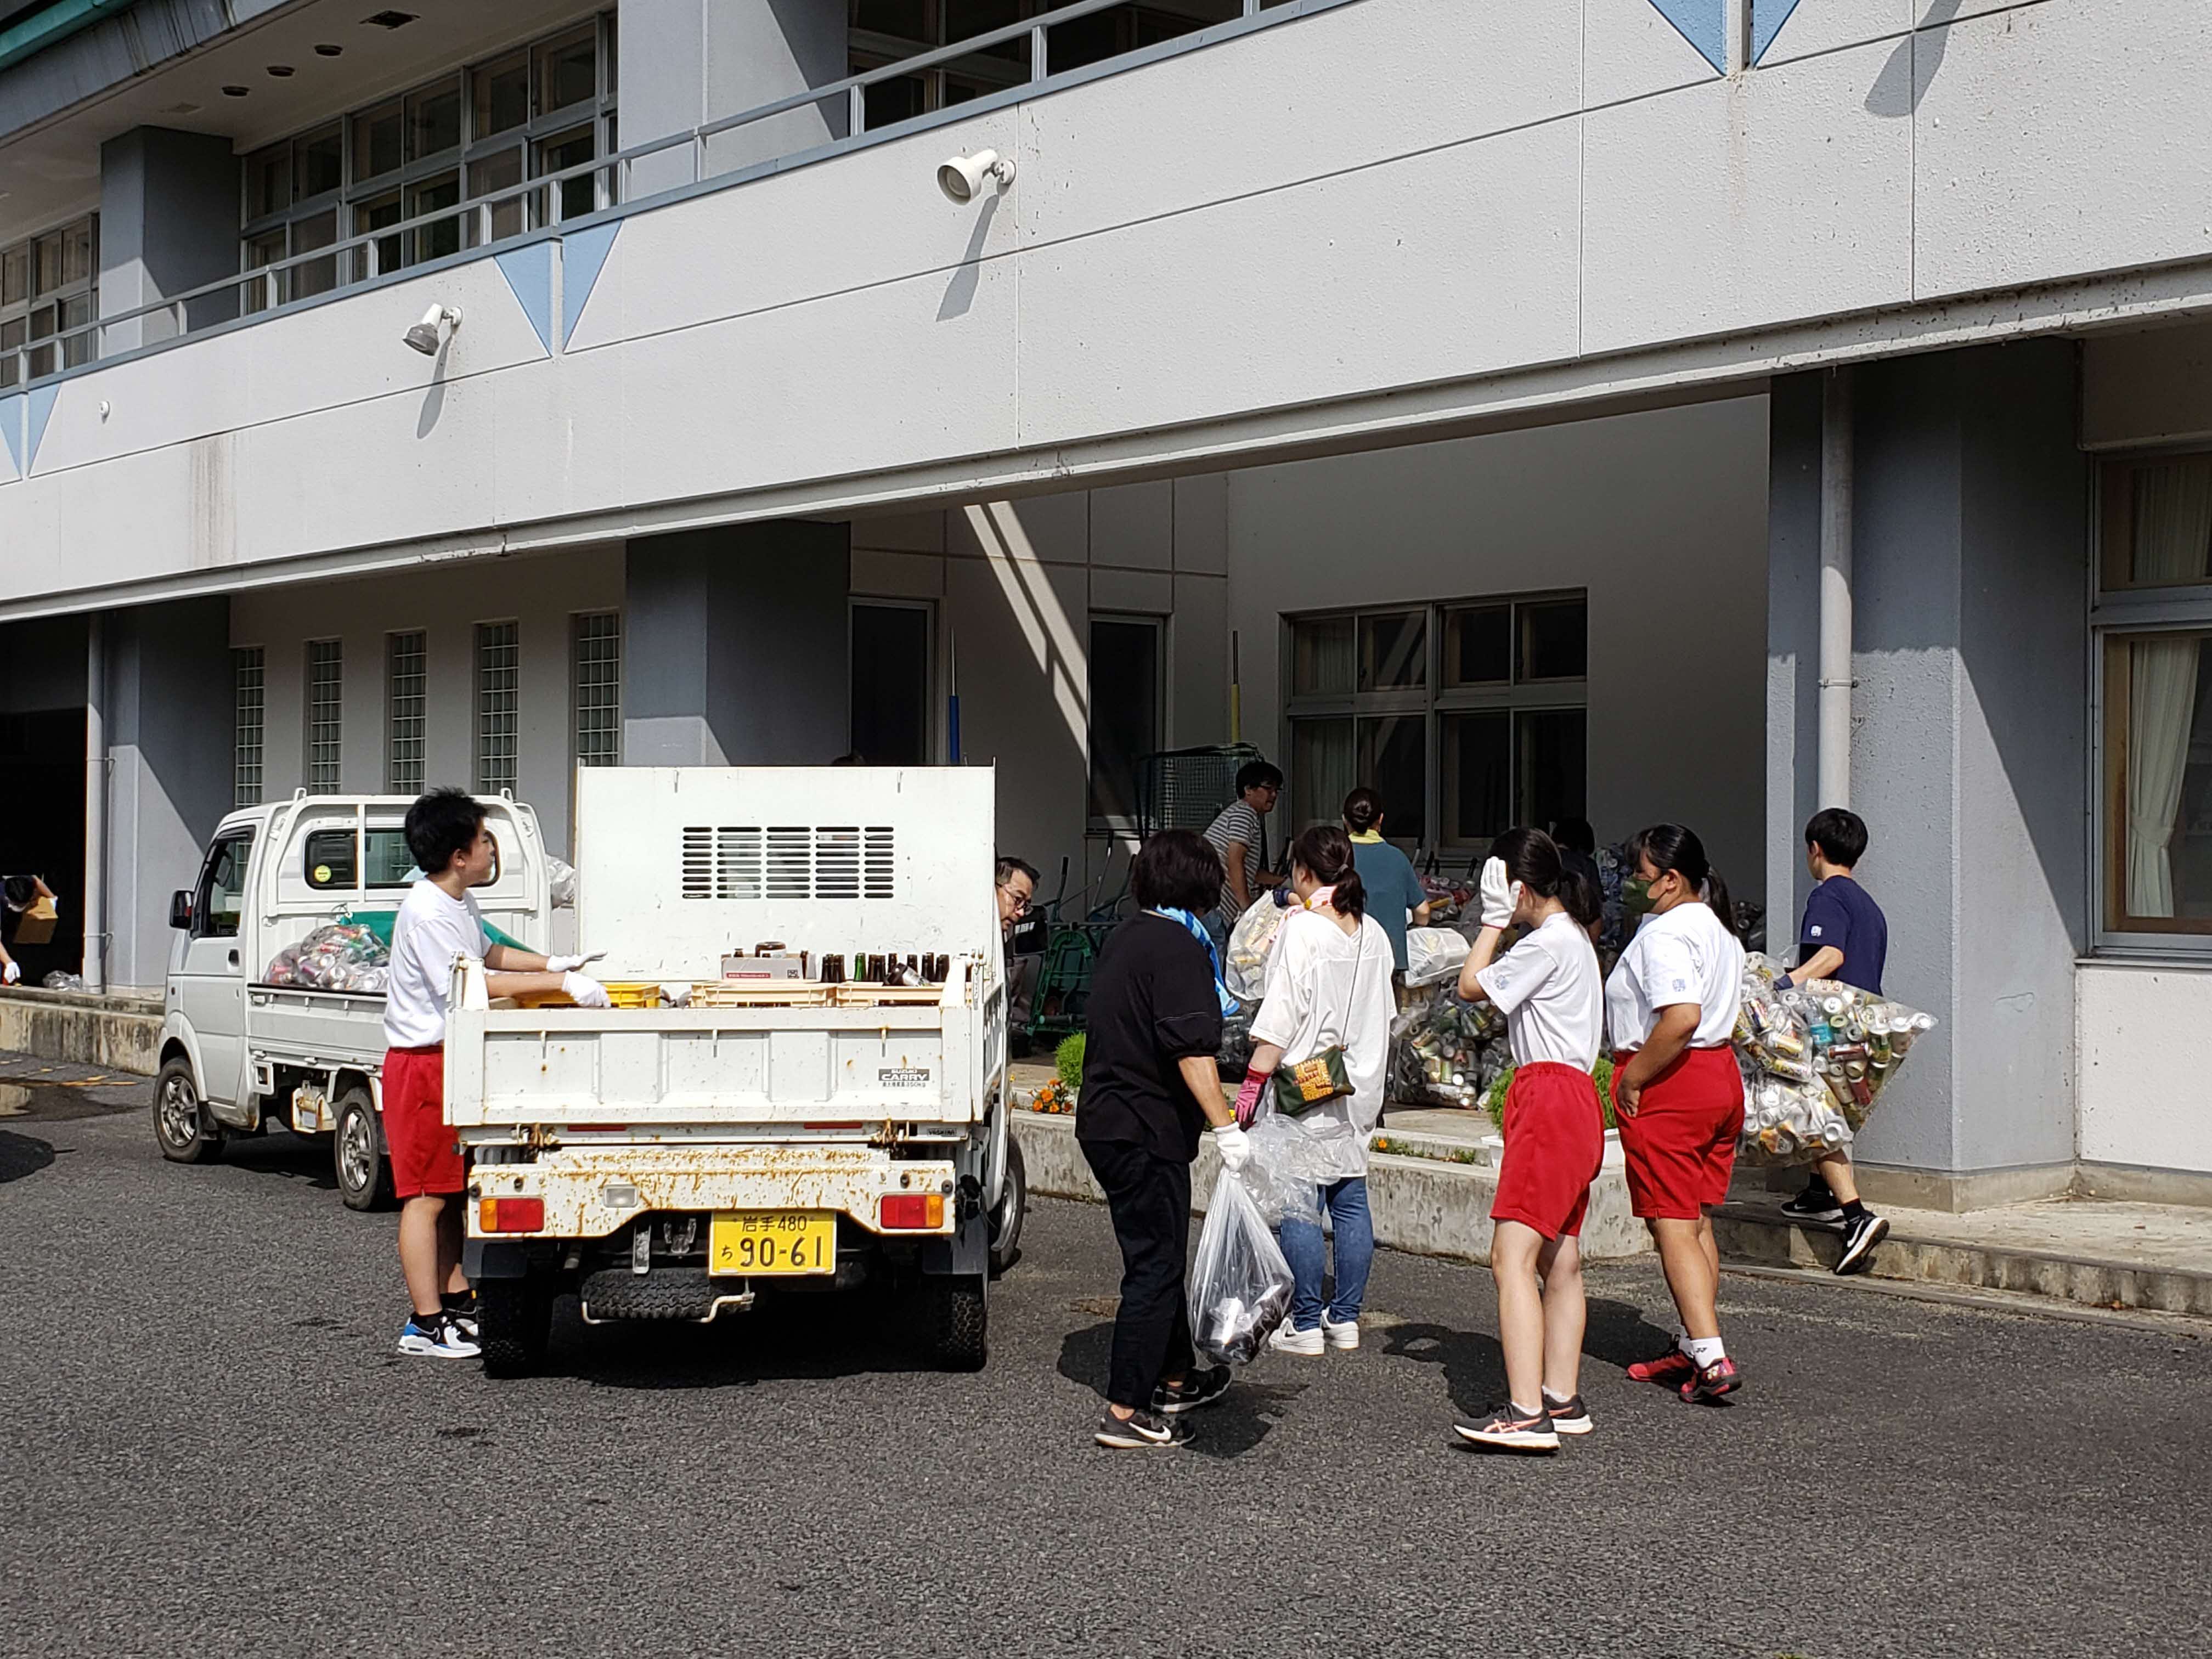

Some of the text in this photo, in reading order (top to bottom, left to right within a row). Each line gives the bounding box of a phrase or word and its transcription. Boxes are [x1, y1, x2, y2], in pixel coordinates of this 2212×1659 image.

[742, 1215, 807, 1232] 岩手480
[721, 1237, 822, 1267] ち 90-61
